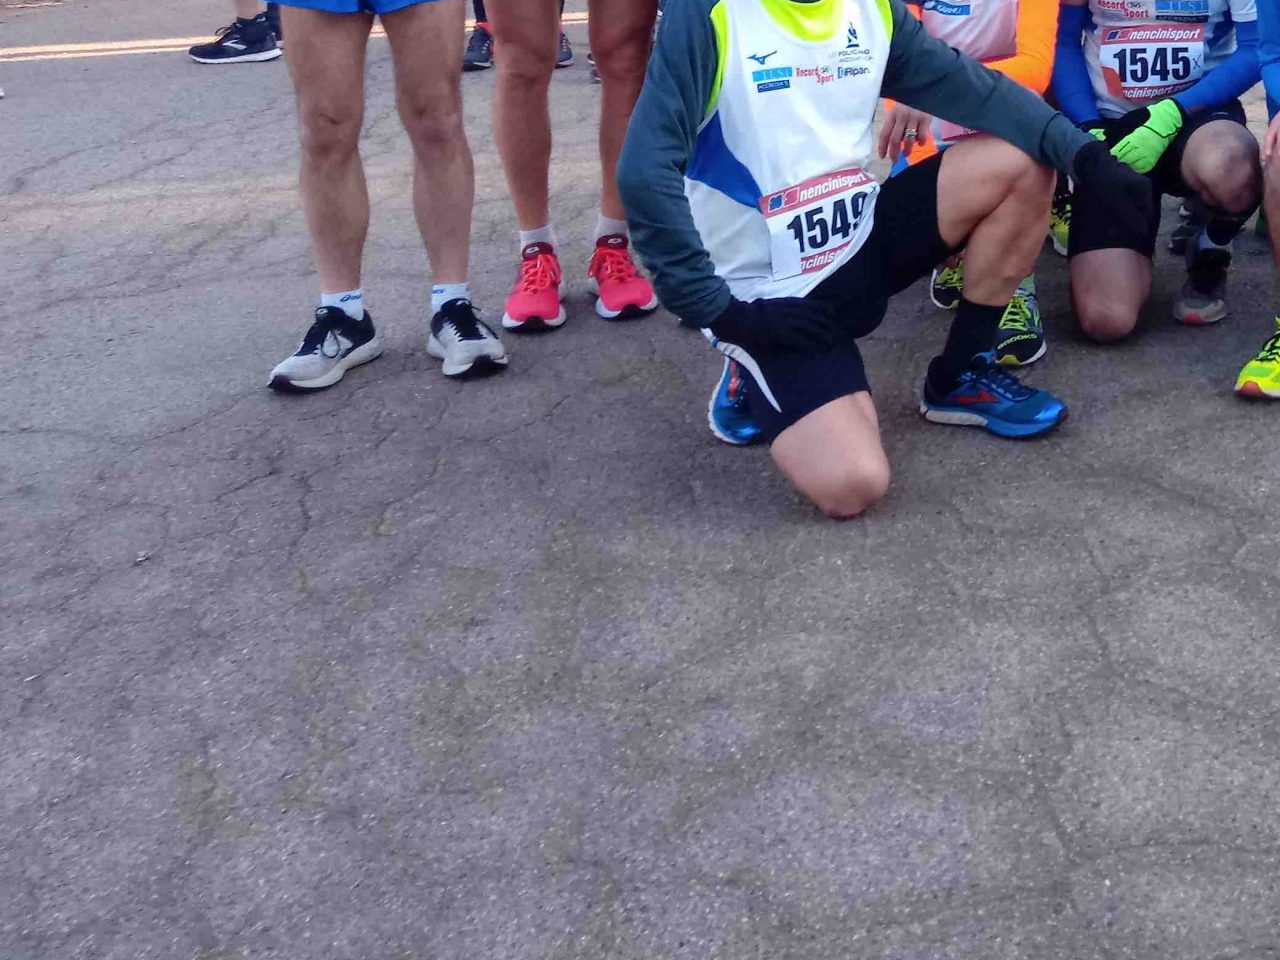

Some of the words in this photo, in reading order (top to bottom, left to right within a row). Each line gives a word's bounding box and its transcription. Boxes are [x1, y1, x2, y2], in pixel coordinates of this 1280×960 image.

[1124, 8, 1149, 18] Sport
[1129, 28, 1200, 41] nencinisport
[1113, 47, 1191, 83] 1545
[796, 66, 819, 77] Record
[816, 74, 834, 85] Sport
[799, 171, 866, 202] nencinisport
